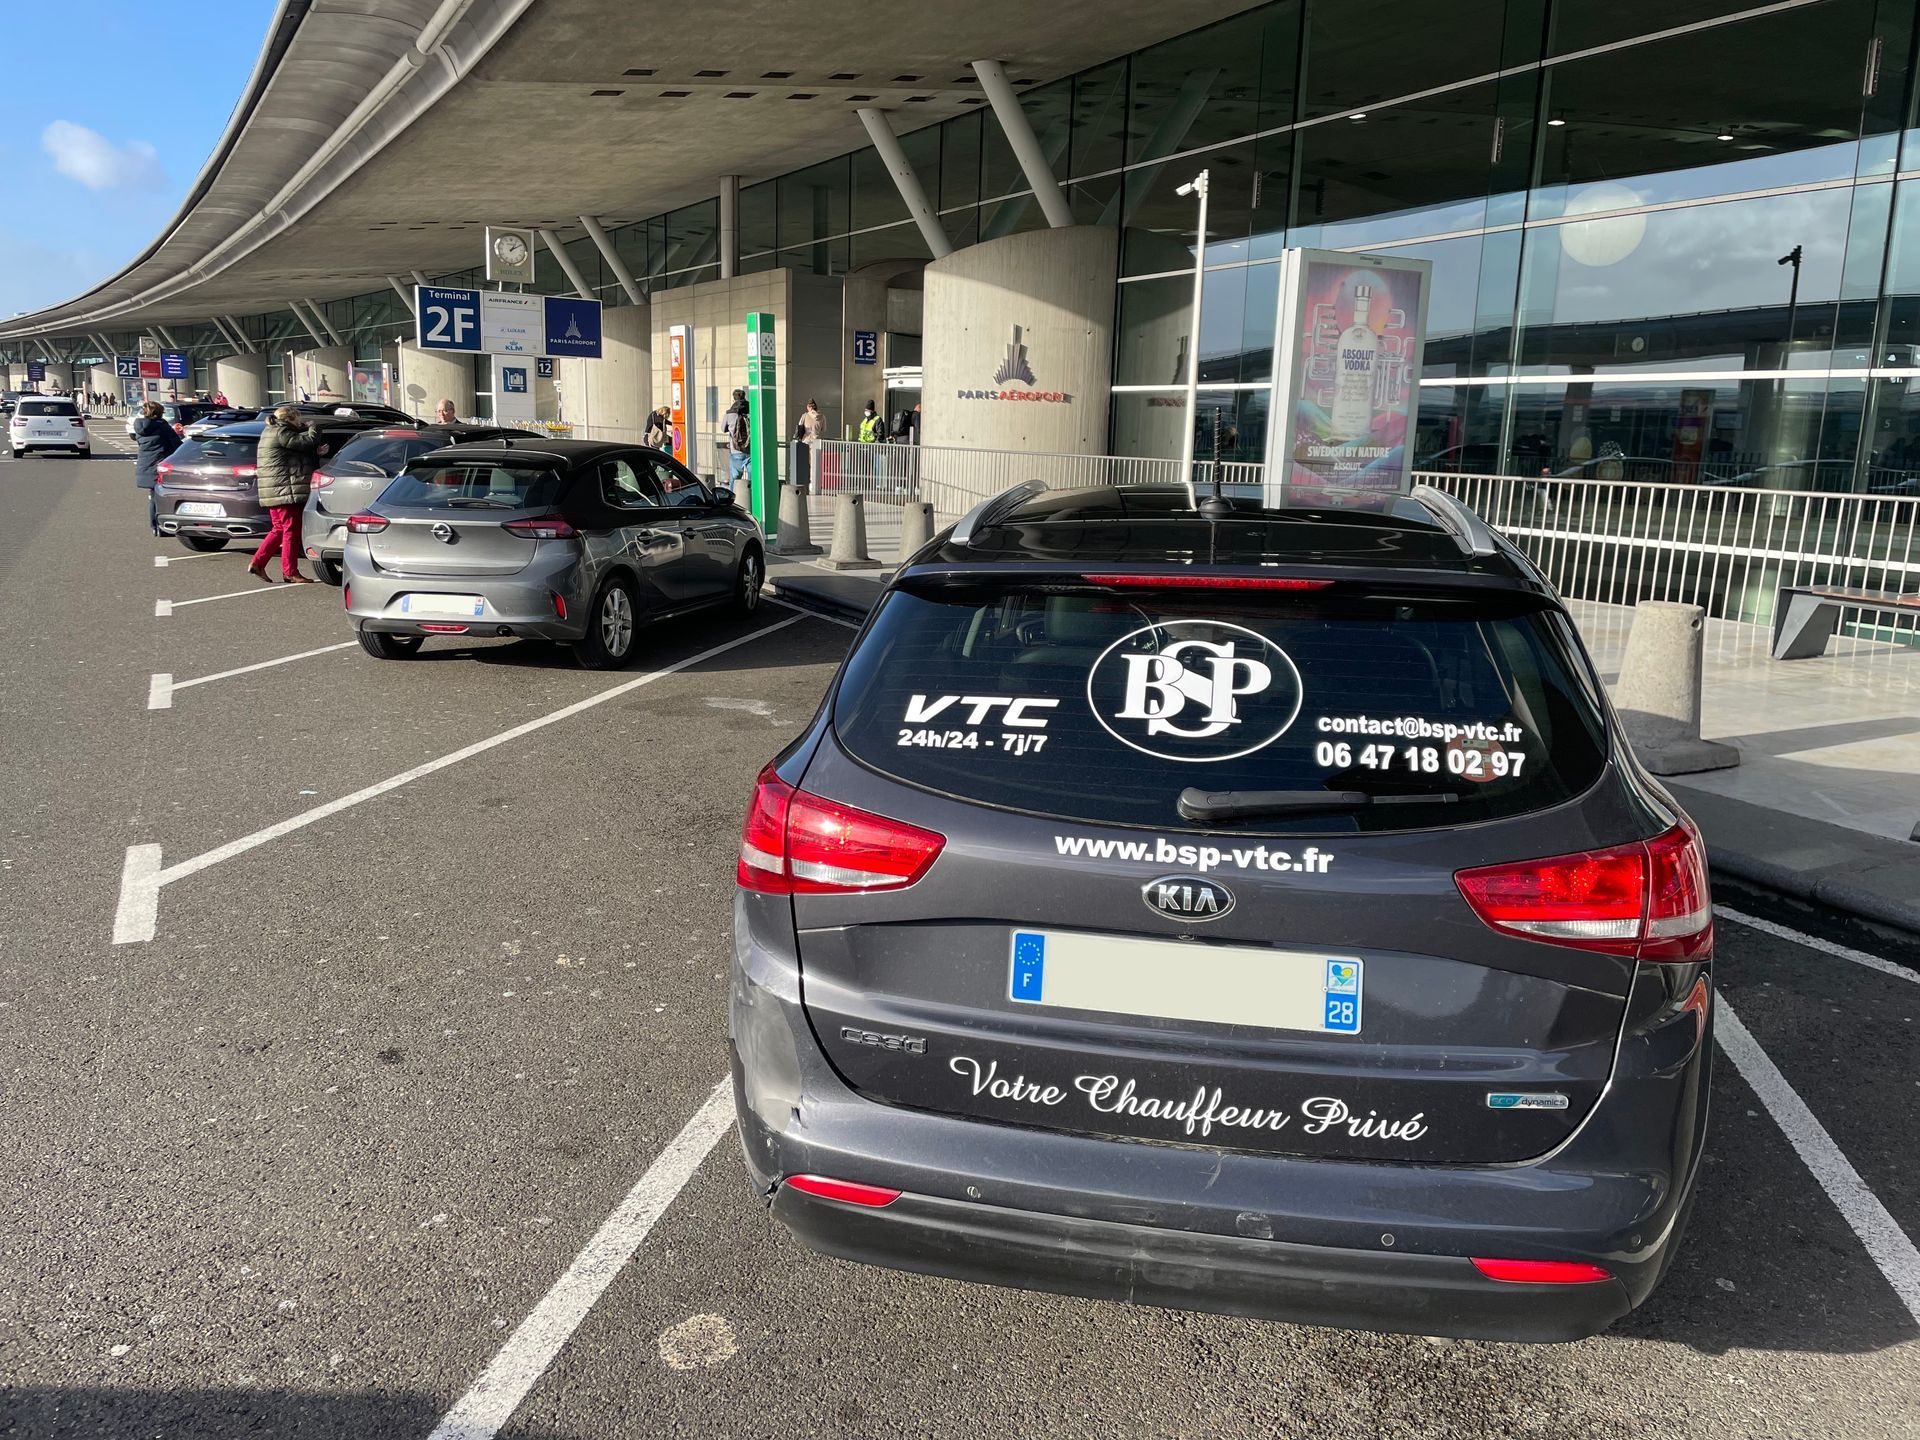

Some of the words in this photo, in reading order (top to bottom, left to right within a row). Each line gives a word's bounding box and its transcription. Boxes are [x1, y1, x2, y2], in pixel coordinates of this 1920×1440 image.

[428, 289, 470, 301] Terminal
[426, 305, 474, 343] 2F
[856, 339, 876, 357] 13
[1342, 348, 1375, 360] ABSOLUT
[118, 362, 137, 375] 2F
[538, 362, 552, 374] 12
[1344, 359, 1371, 371] VODKA
[1307, 445, 1345, 458] SWEDISH
[1345, 447, 1358, 458] BY
[1358, 447, 1390, 459] NATURE
[903, 694, 1061, 728] VTC
[1318, 715, 1523, 743] contact@bsp-vtc.fr
[897, 729, 979, 750] 24h/24
[1001, 733, 1049, 757] 7j/7
[1316, 741, 1352, 768] 06
[1359, 744, 1396, 770] 47
[1404, 746, 1440, 773] 18
[1447, 748, 1484, 775] 02
[1490, 751, 1526, 777] 97
[1054, 836, 1335, 873] www.bsp-vtc.fr
[1157, 883, 1219, 913] KIA
[1022, 972, 1033, 988] F
[1328, 1000, 1354, 1025] 28
[949, 1055, 1068, 1106] Votre
[1074, 1074, 1291, 1137] Chauffeur
[1301, 1096, 1429, 1142] Privé
